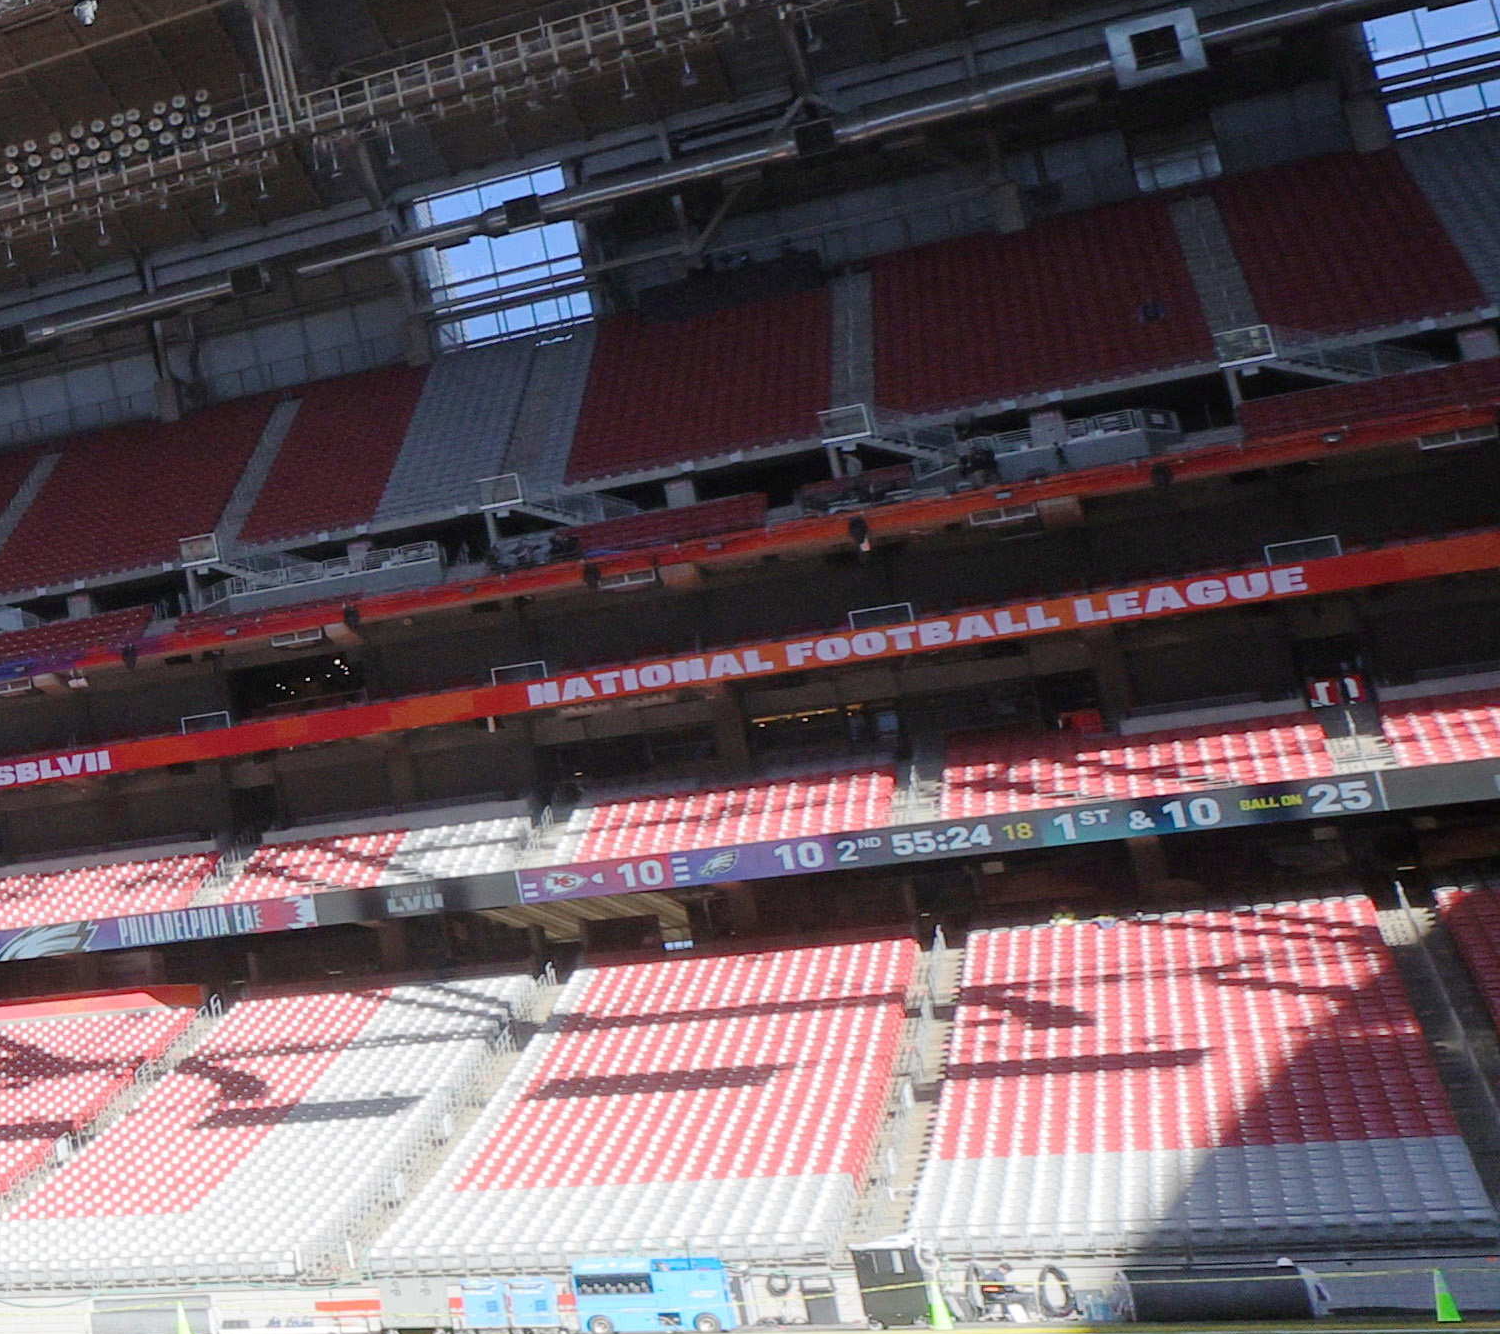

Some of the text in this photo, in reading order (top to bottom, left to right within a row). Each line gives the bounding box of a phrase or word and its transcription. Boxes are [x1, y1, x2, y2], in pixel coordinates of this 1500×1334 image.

[527, 566, 1310, 707] NATIONAL FOOTBALL LEAGUE
[618, 859, 665, 888] 10
[773, 841, 825, 871] 10
[836, 835, 882, 863] 2ND
[891, 823, 993, 856] 55:24
[1002, 821, 1033, 842] 18
[1053, 809, 1110, 841] 1ST
[1128, 809, 1156, 832] &
[1162, 797, 1222, 829] 10
[1238, 795, 1280, 812] BALL
[1281, 793, 1303, 808] ON
[1306, 780, 1373, 815] 25
[117, 906, 231, 946] PHILADELPHIA
